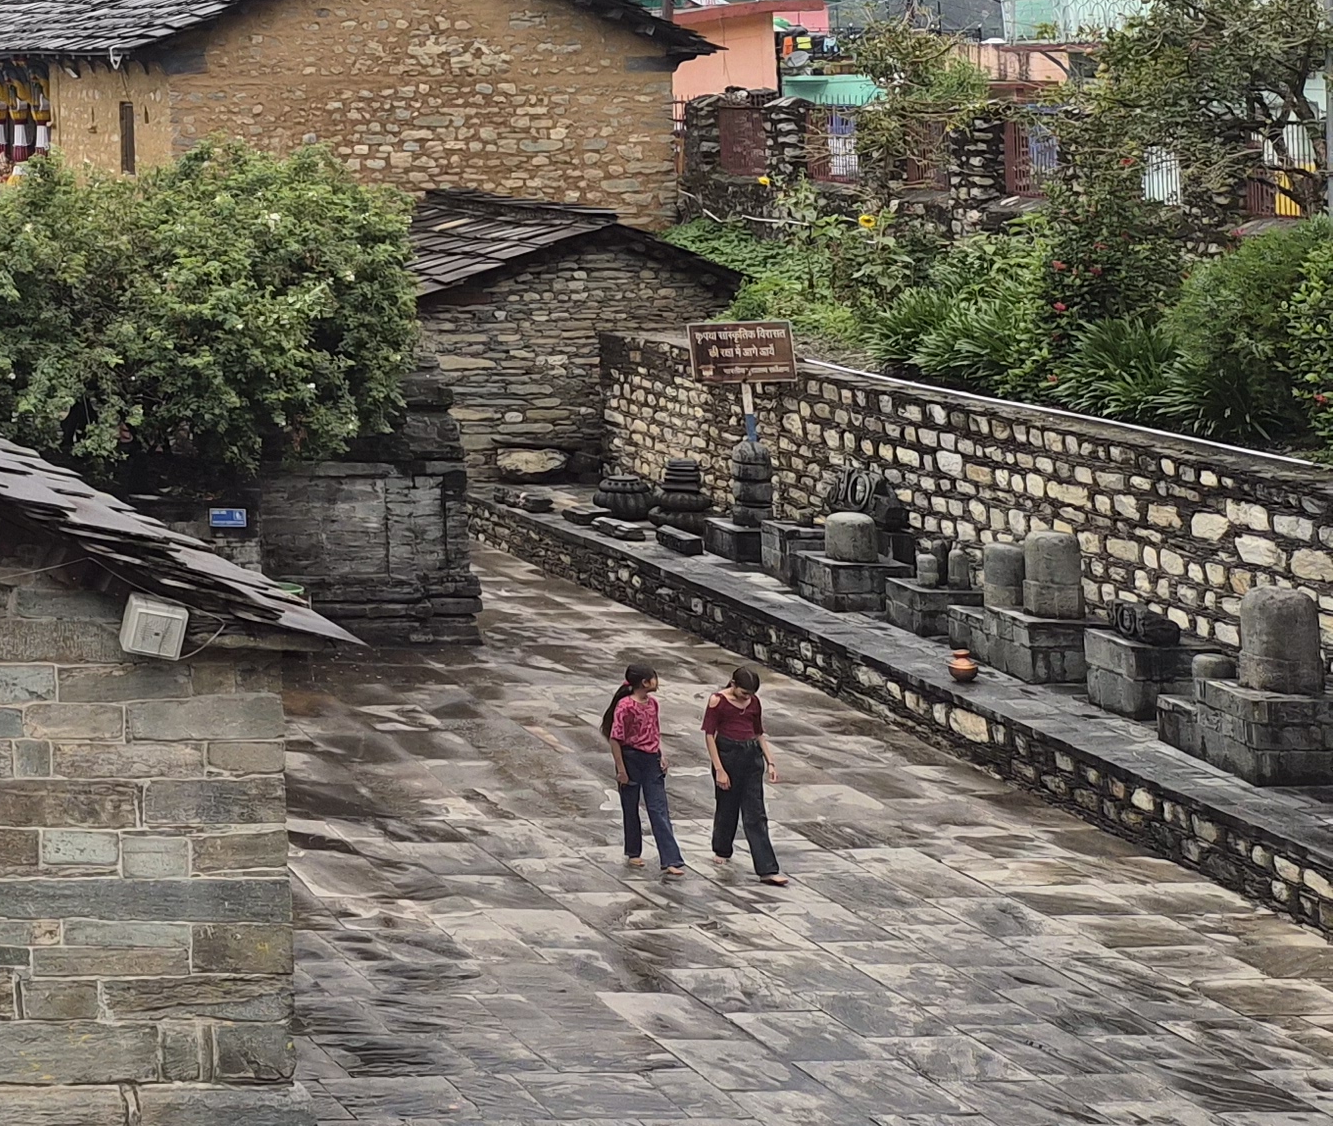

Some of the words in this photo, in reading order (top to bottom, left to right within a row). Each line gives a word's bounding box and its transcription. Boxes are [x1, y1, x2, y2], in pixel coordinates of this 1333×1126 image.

[694, 331, 717, 345] कृपया
[717, 327, 756, 344] सांस्कृतिक
[756, 326, 786, 339] विरासत
[708, 345, 719, 358] की
[742, 344, 758, 357] आगे
